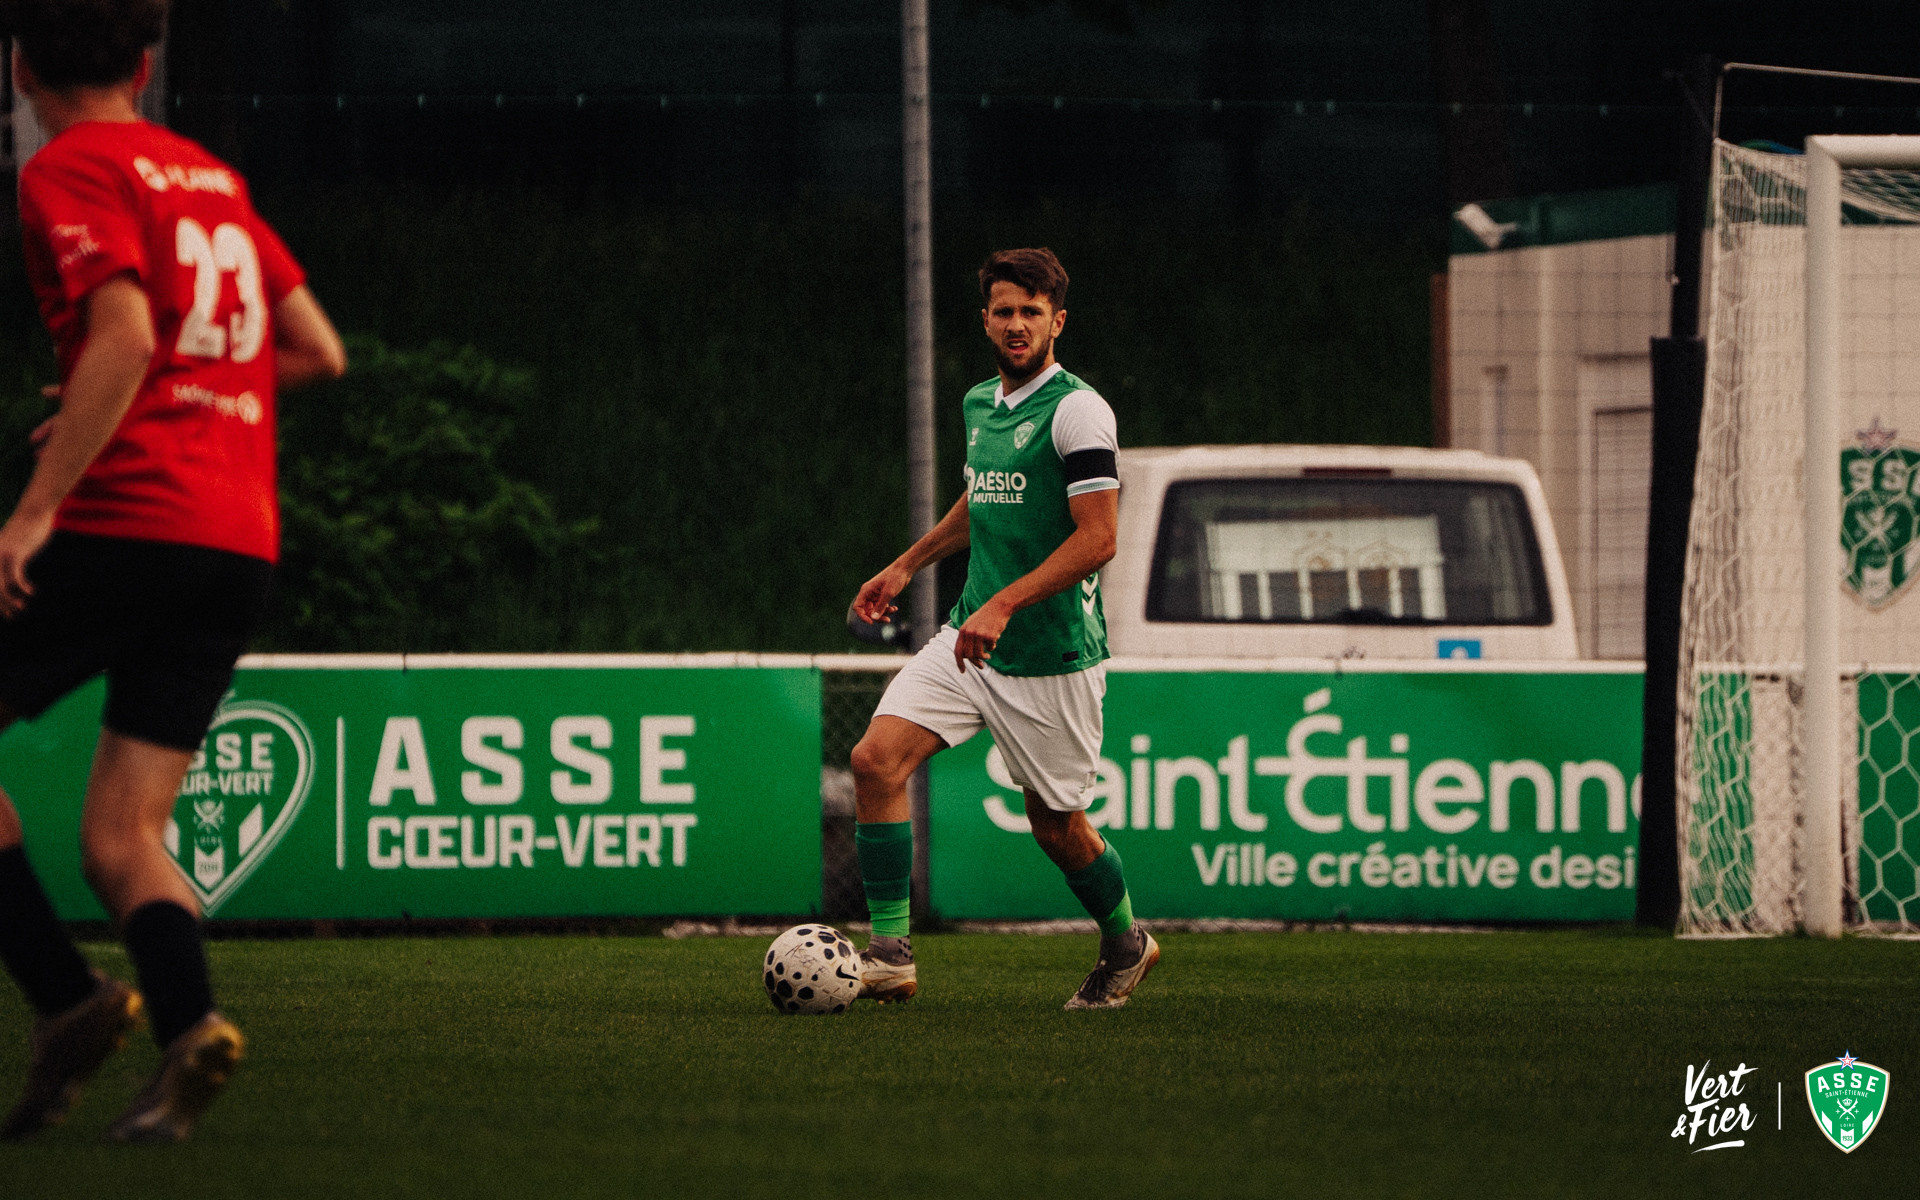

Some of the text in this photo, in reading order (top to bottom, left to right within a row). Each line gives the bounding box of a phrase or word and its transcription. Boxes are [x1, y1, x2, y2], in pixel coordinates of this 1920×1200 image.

[175, 216, 268, 363] 23
[973, 492, 1024, 504] MUTUELLE
[974, 471, 1027, 491] AÉSIO
[178, 771, 274, 796] UR-VERT
[369, 715, 697, 806] ASSE
[367, 814, 699, 870] CŒUR-VERT
[1191, 841, 1637, 890] Ville créative desi
